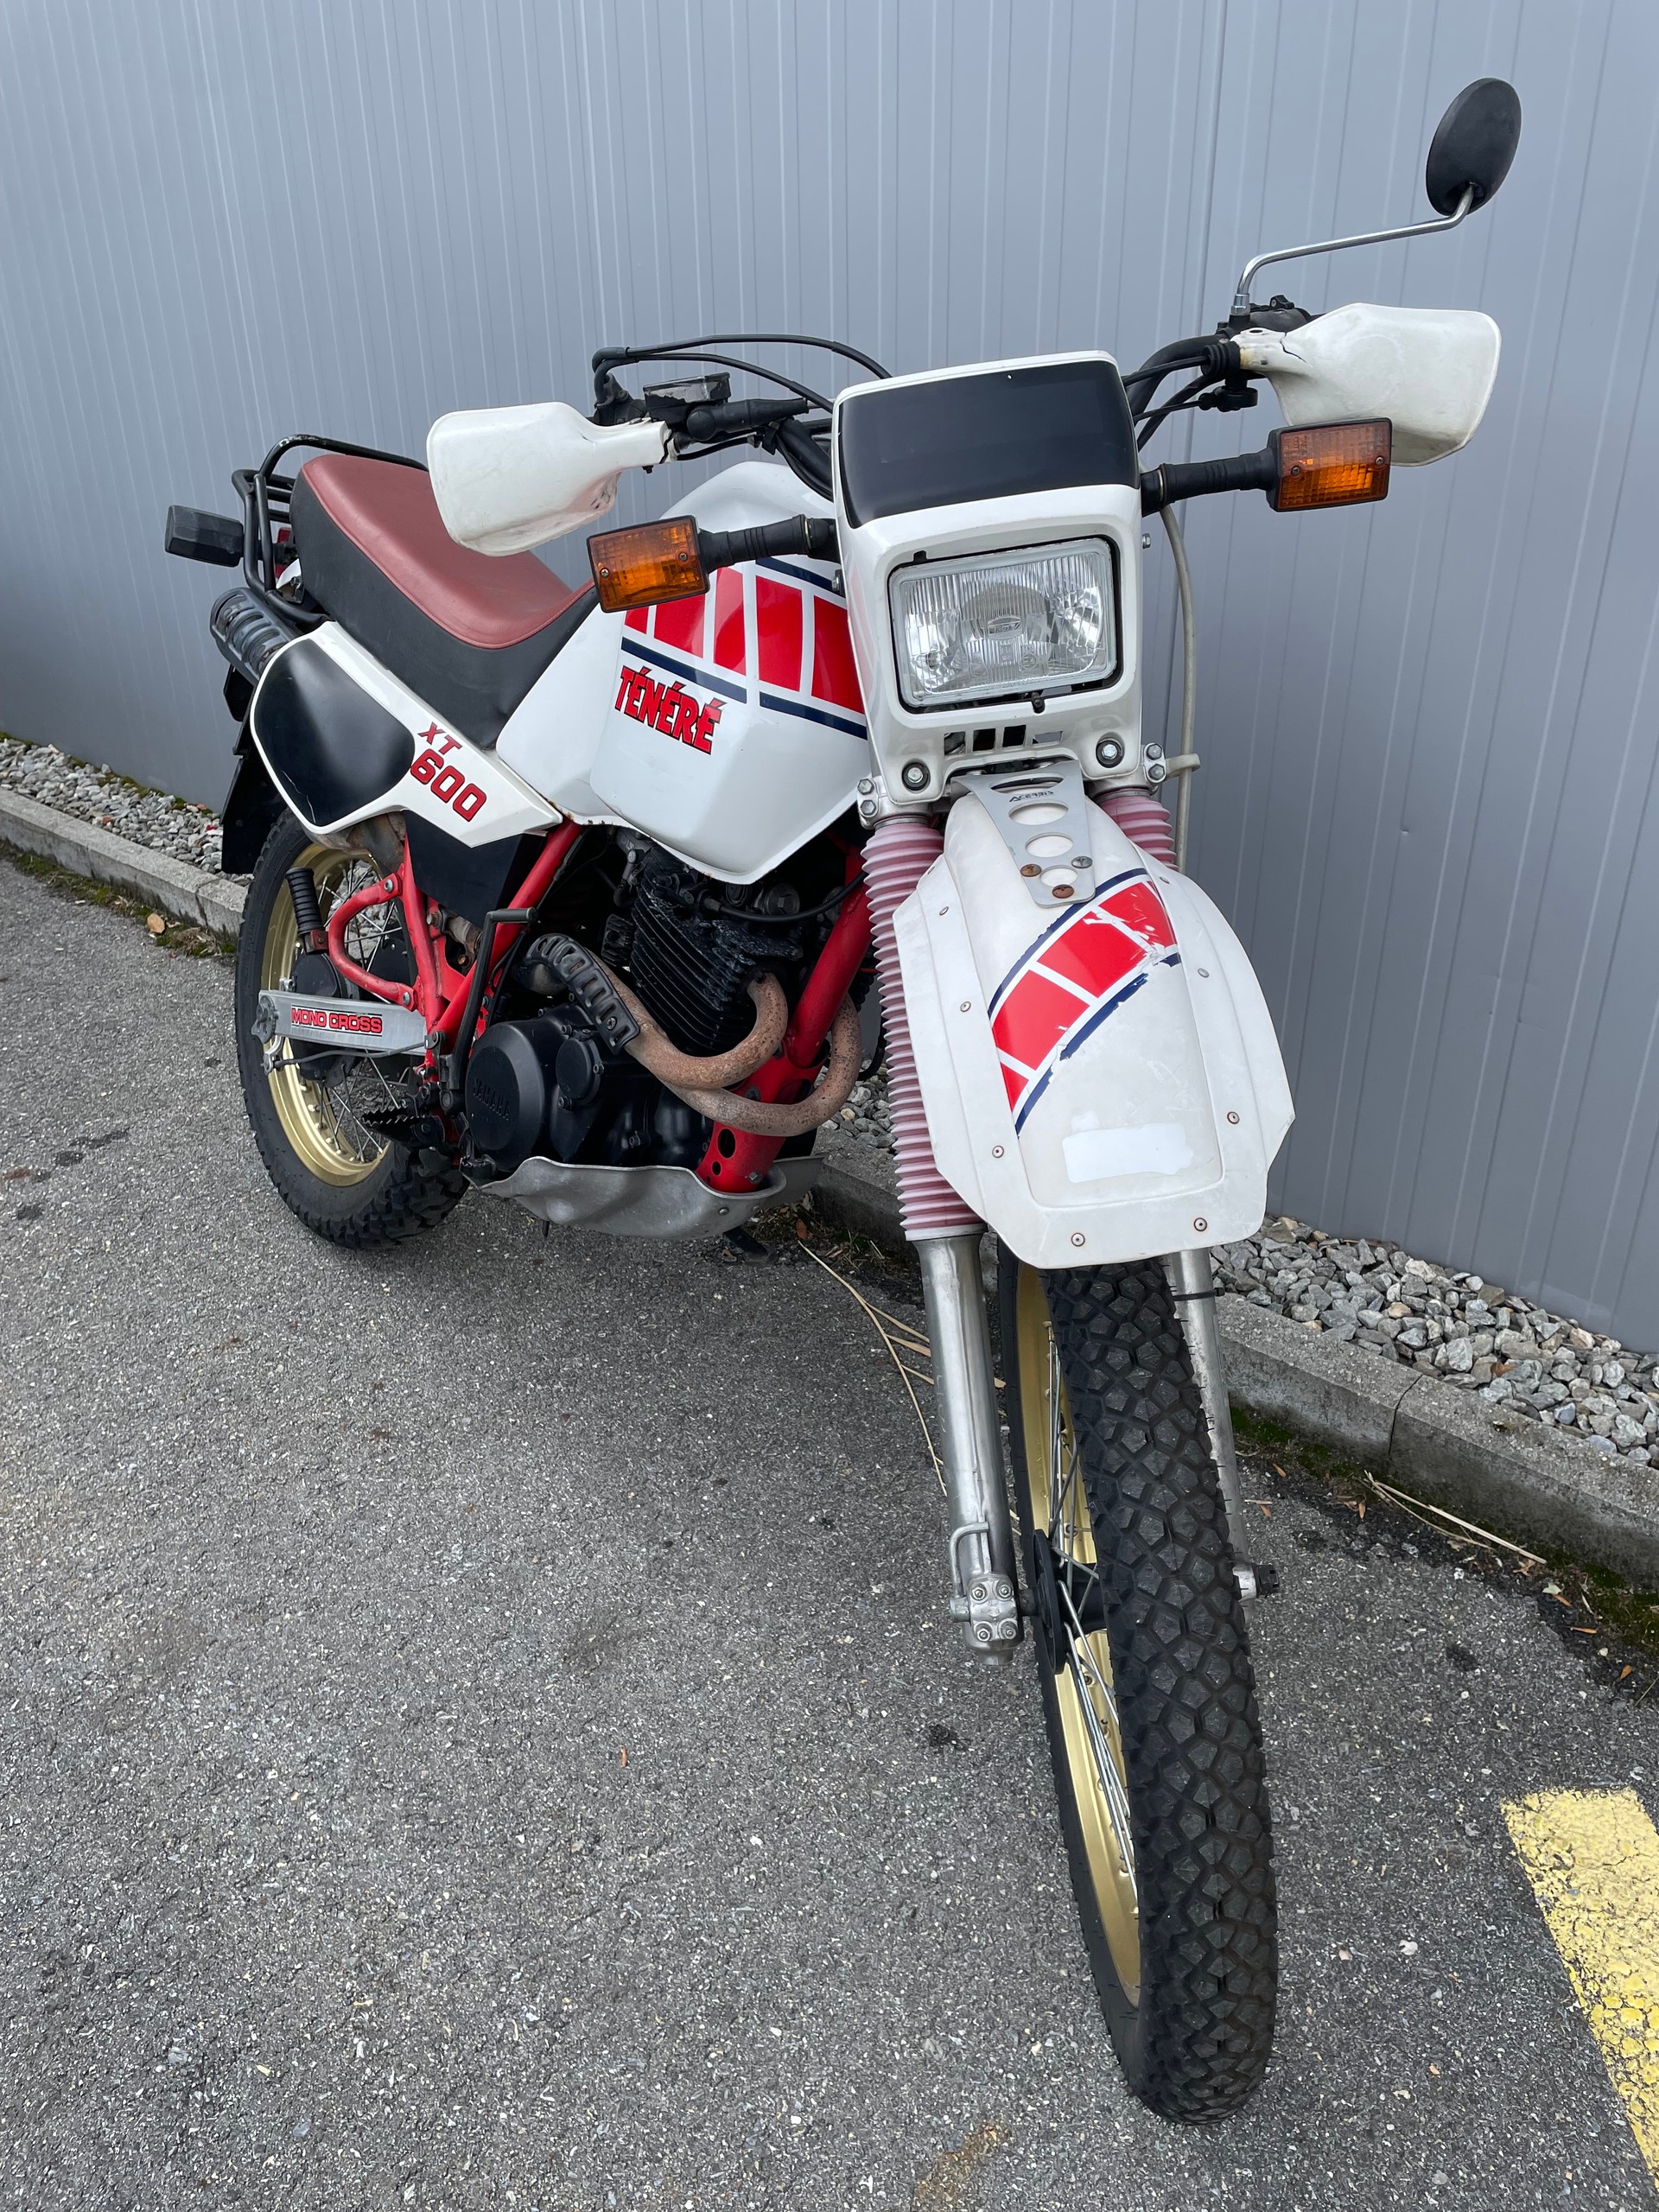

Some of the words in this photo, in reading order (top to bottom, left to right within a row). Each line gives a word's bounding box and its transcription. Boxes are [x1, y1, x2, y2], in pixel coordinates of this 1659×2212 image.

[614, 664, 728, 755] TÉNÉRÉ
[417, 721, 463, 755] XT
[410, 748, 487, 823] 600
[291, 1007, 327, 1027] MONO
[329, 1014, 383, 1033] CROSS
[473, 1077, 511, 1121] YAMAHA
